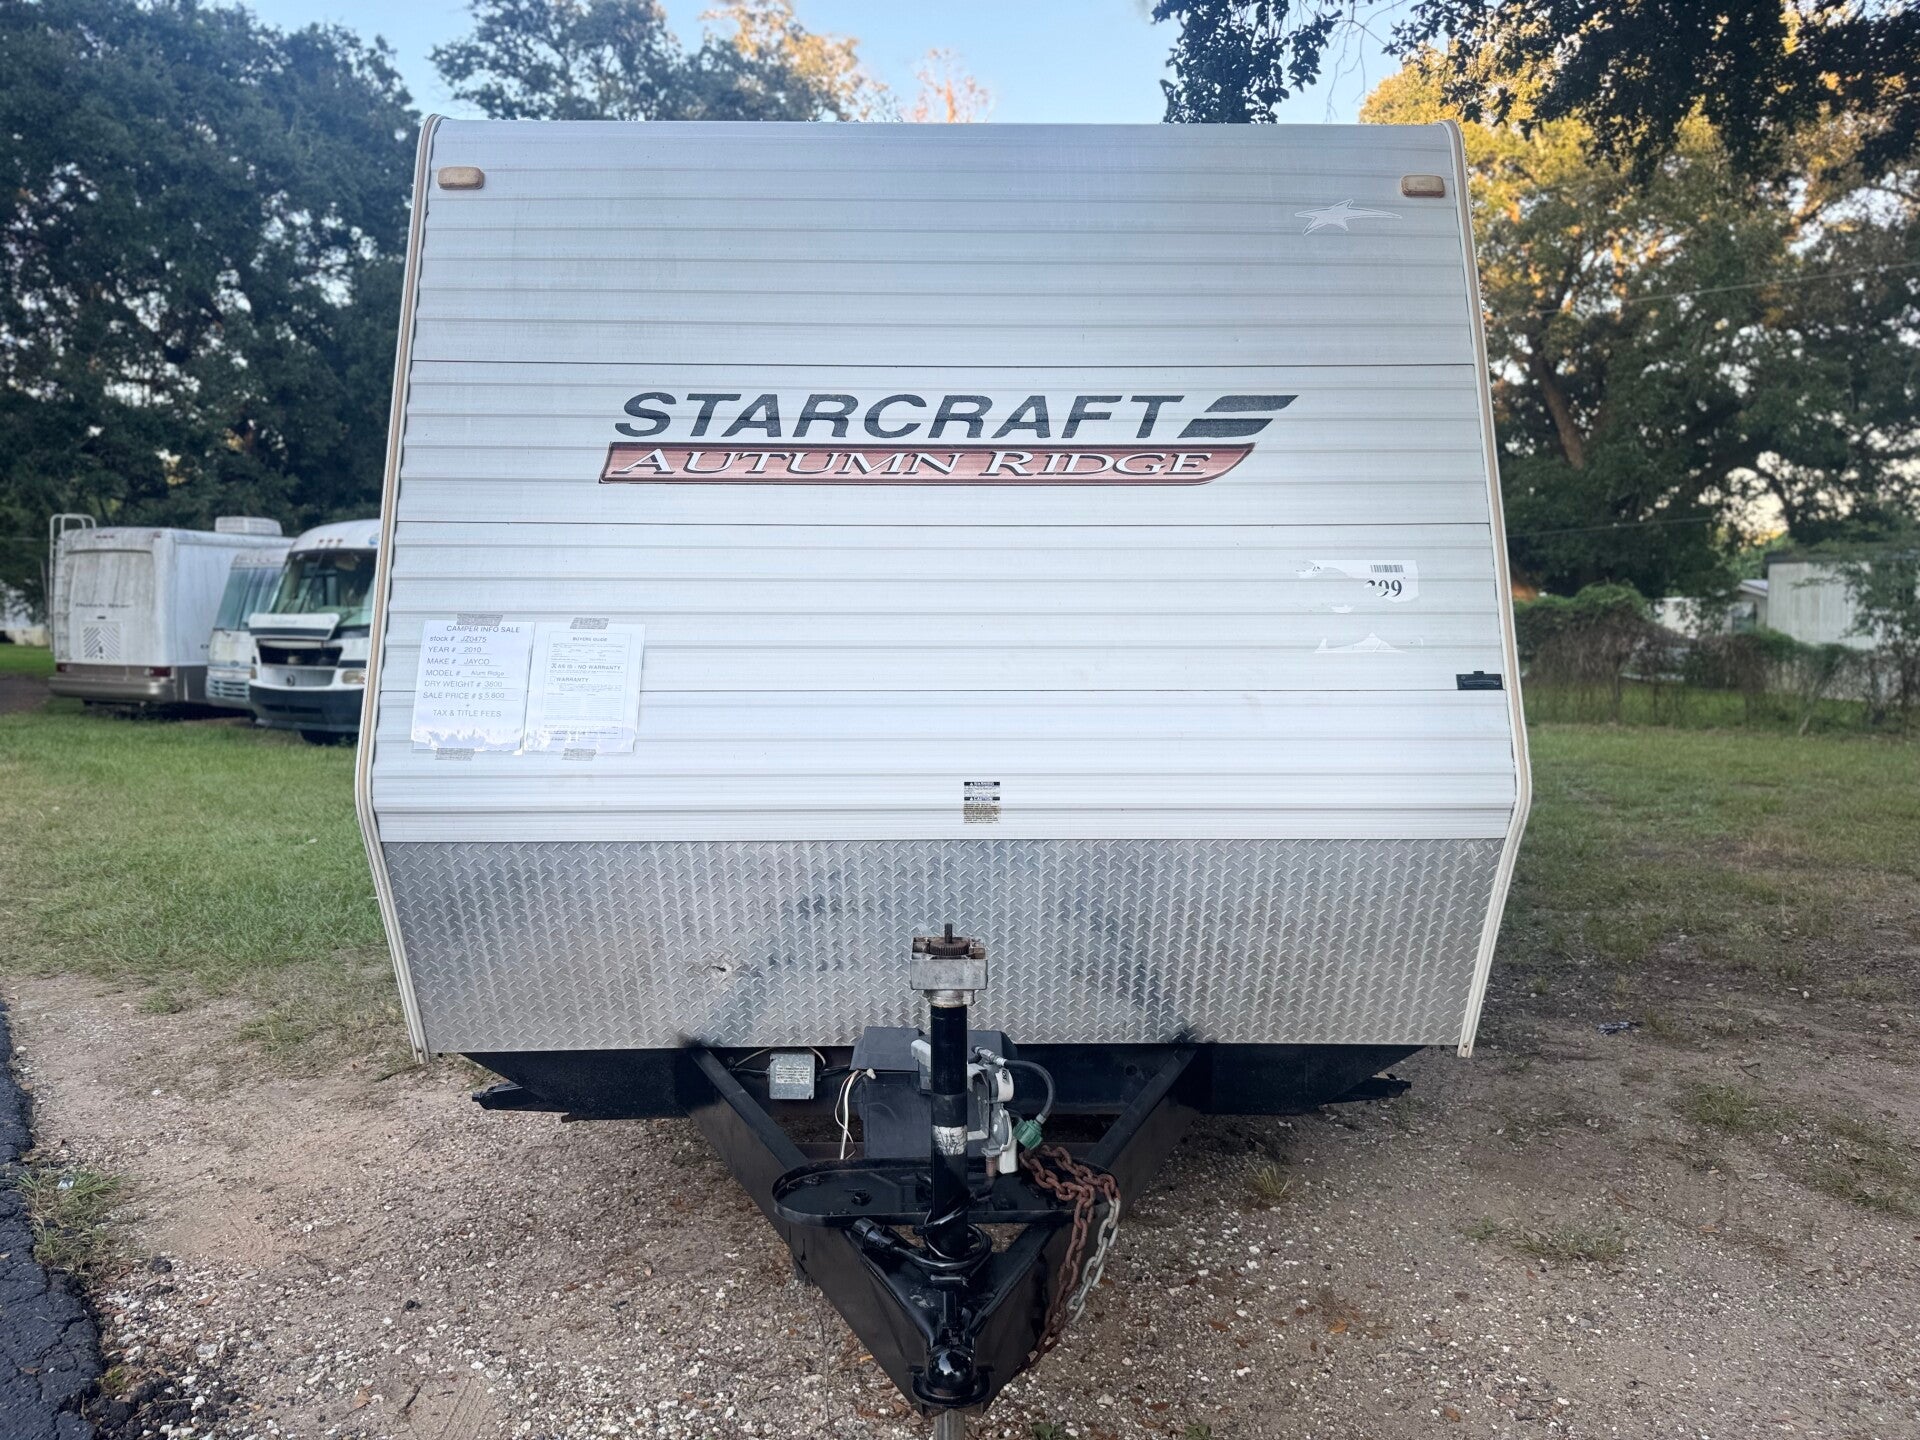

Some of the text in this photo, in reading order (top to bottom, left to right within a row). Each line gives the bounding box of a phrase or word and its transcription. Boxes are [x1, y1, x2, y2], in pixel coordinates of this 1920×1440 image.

[615, 392, 1184, 439] STARCRAFT
[618, 448, 1214, 477] AUTUMN RIDGE
[1365, 579, 1402, 597] 99
